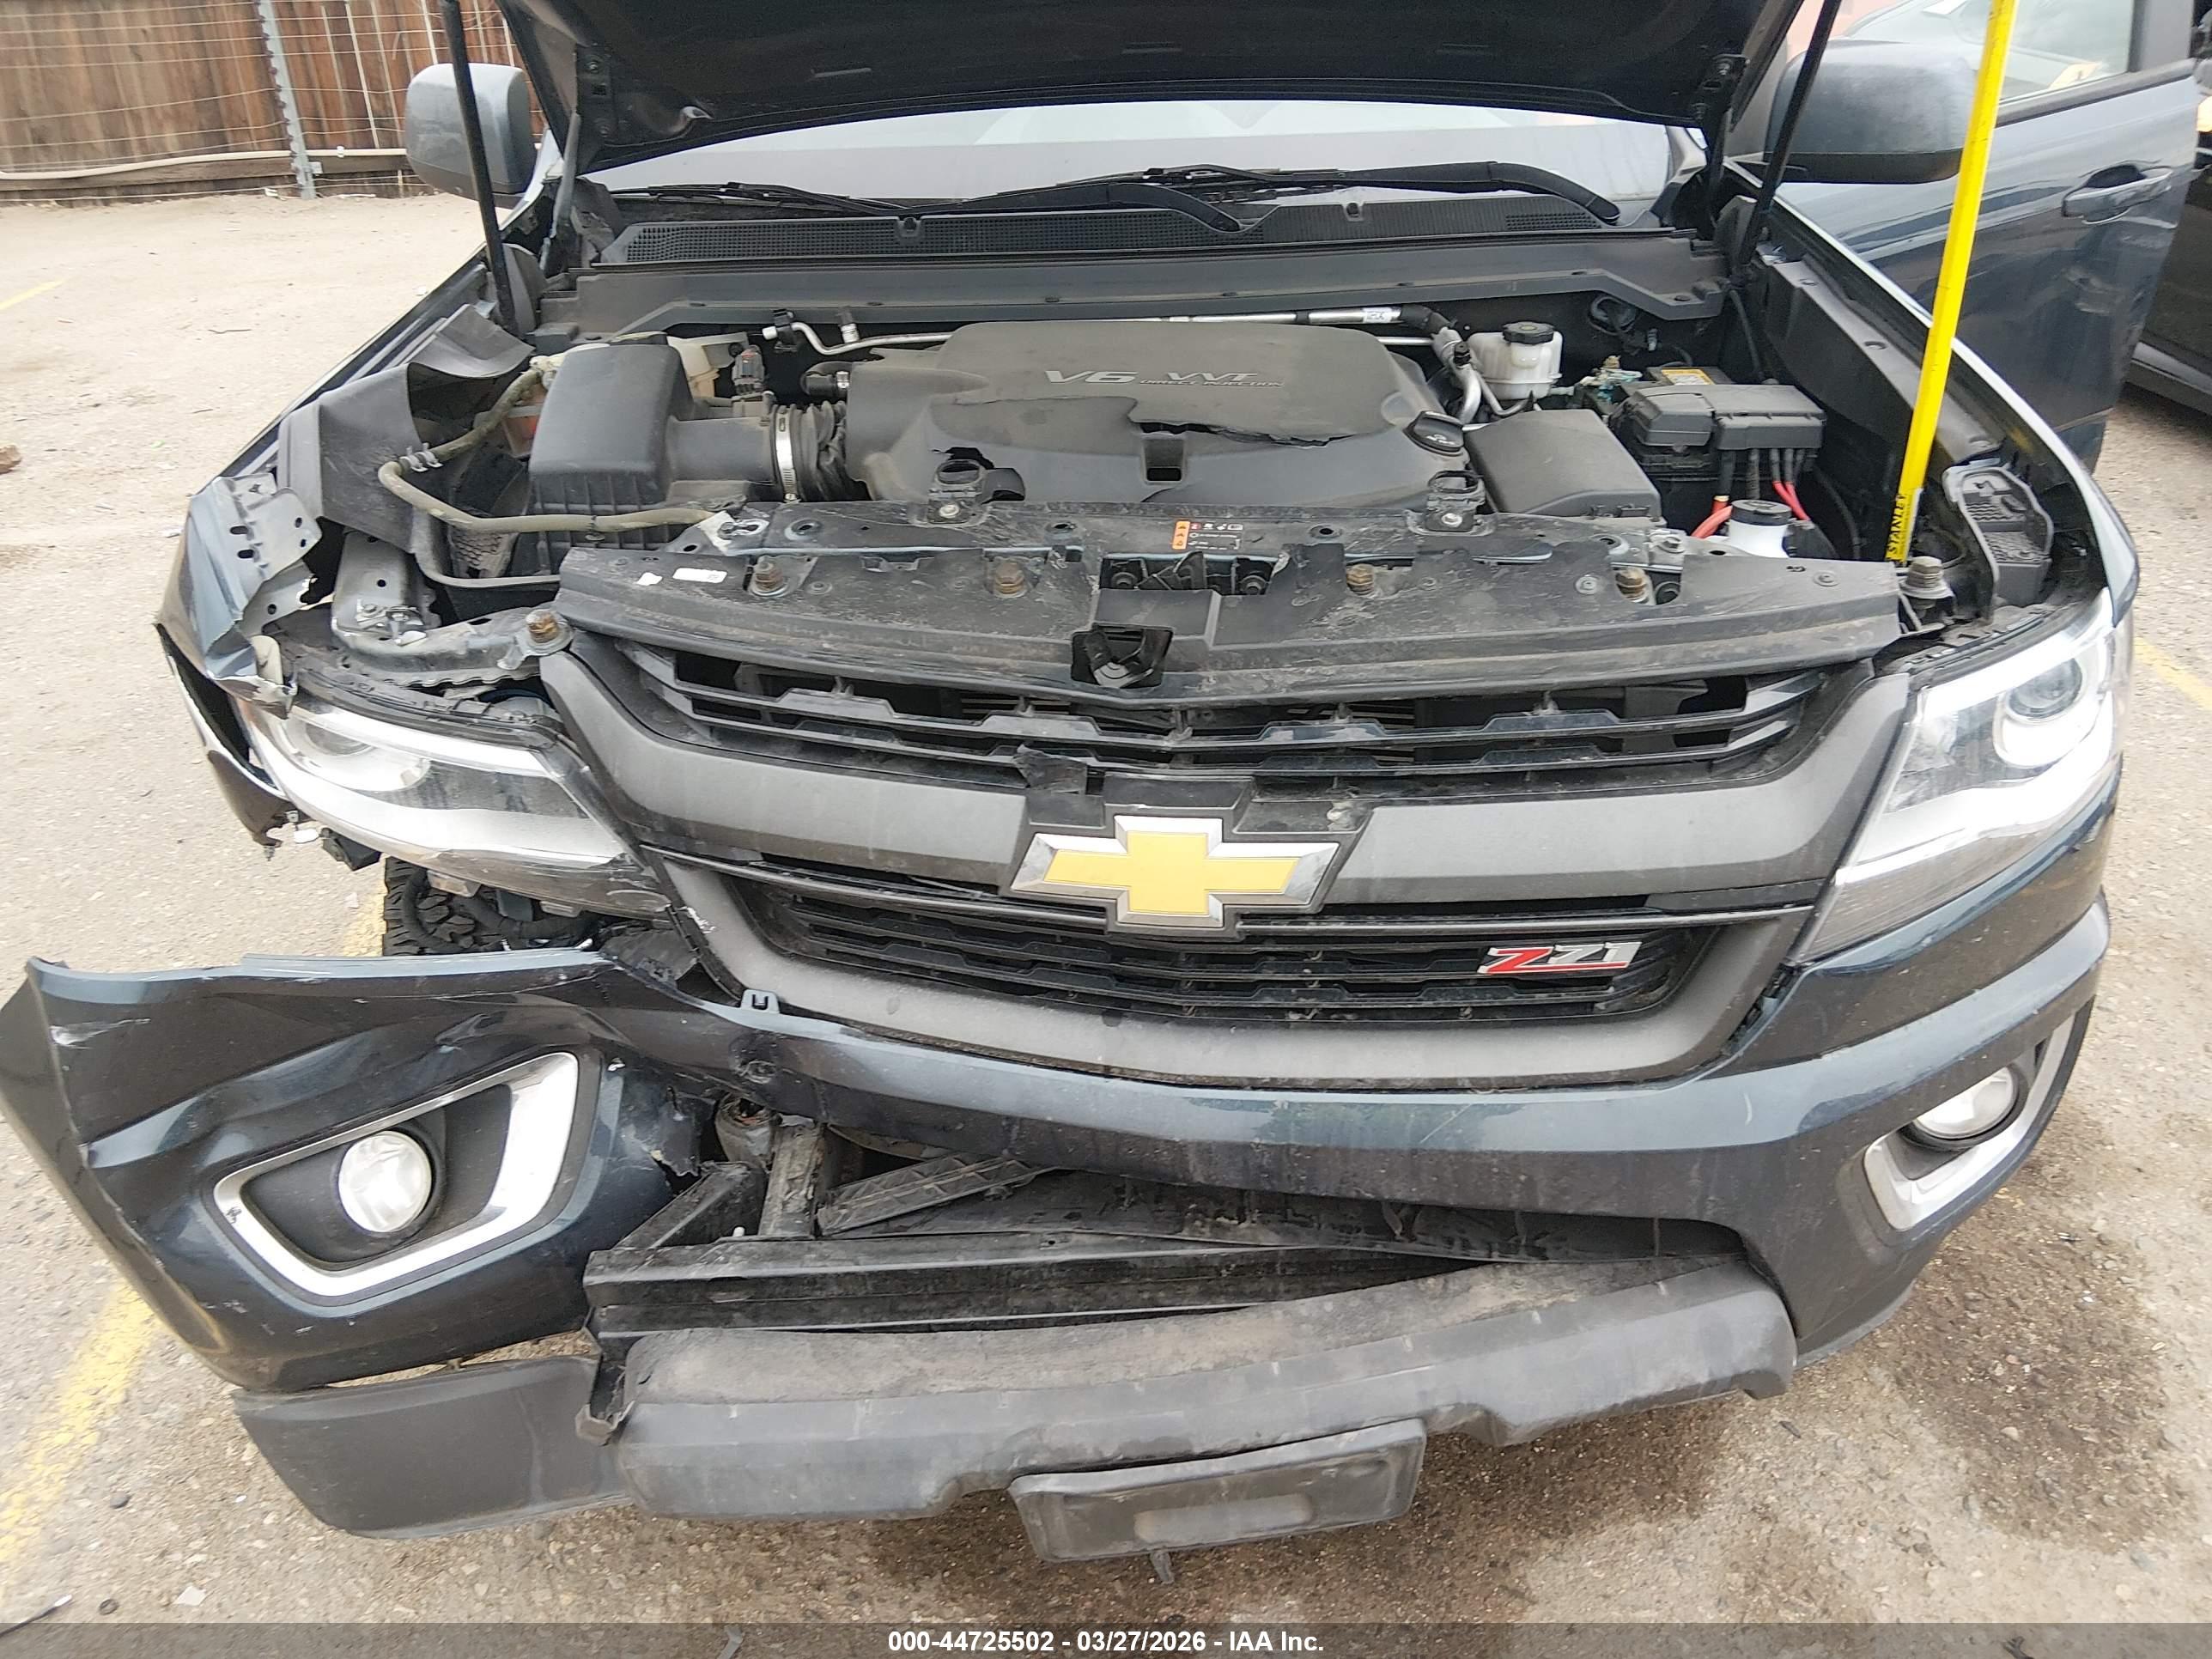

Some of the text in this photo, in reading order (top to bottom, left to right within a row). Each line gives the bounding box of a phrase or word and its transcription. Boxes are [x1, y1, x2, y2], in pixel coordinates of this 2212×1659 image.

[1045, 370, 1258, 384] V6 VVT
[1887, 495, 1905, 554] STANLEY
[1477, 942, 1642, 975] Z71
